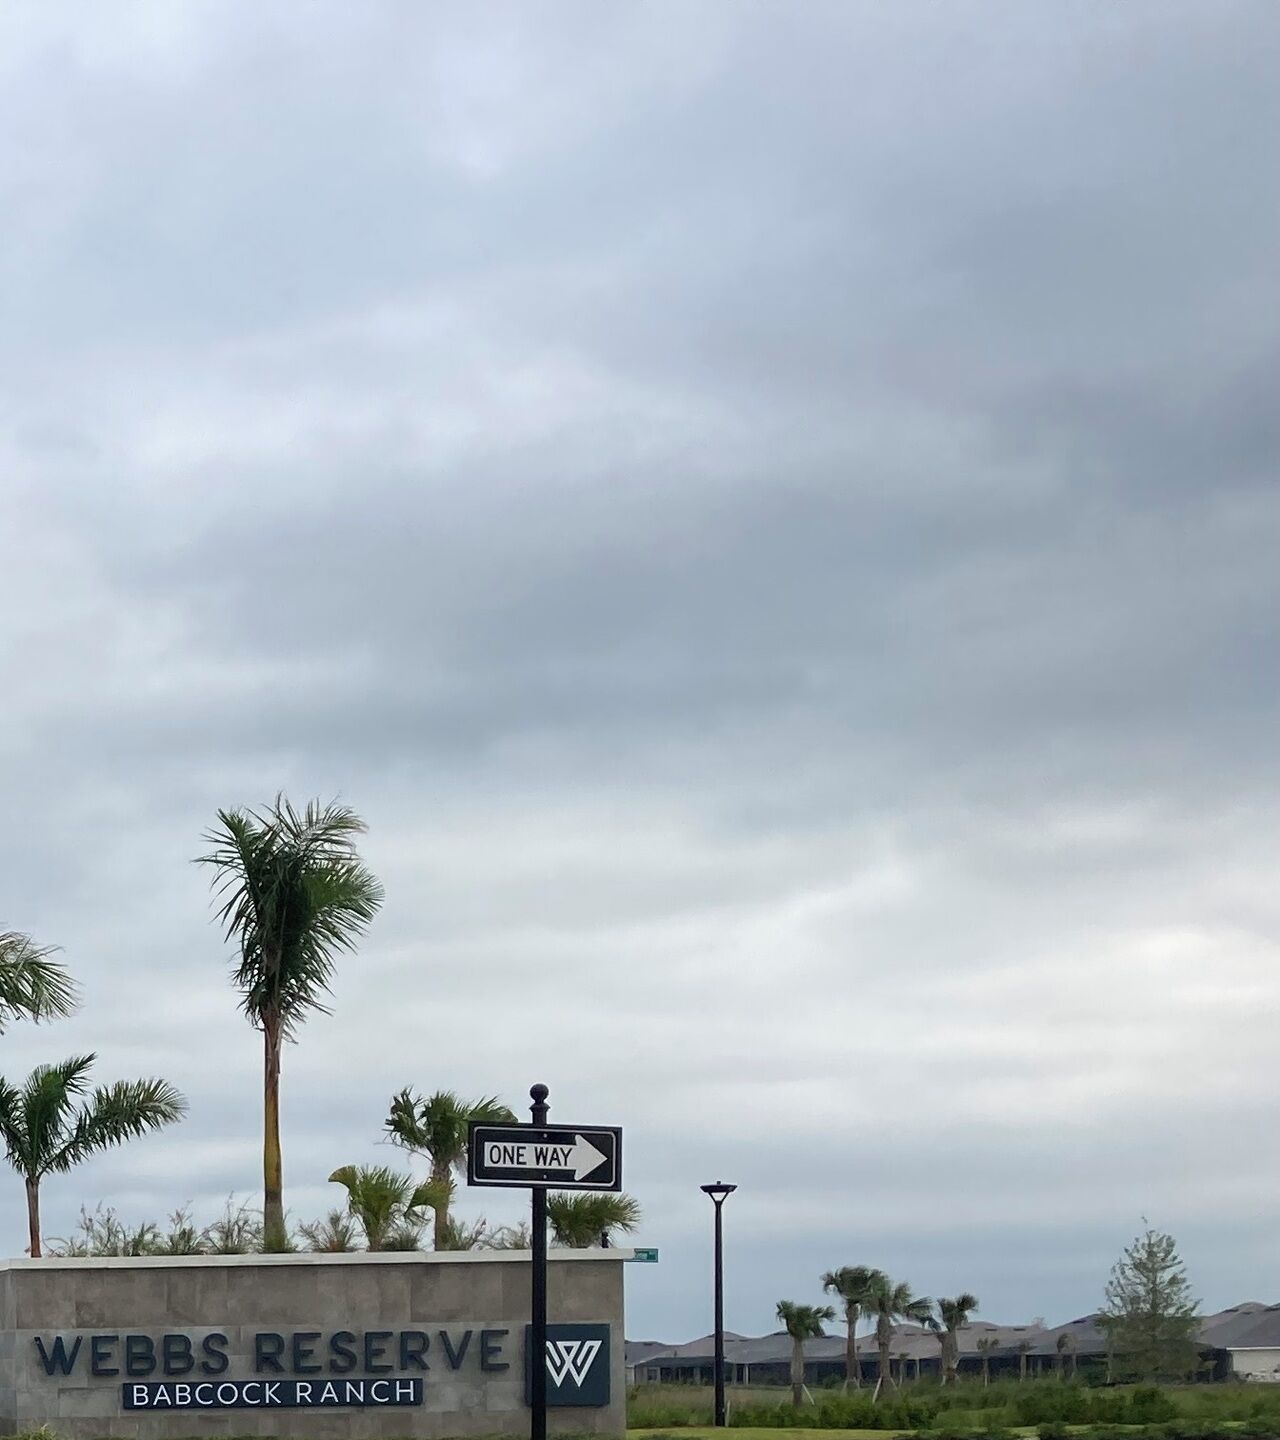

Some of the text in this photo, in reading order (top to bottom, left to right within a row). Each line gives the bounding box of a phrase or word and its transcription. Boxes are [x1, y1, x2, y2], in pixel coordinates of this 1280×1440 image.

[490, 1145, 572, 1166] ONE WAY
[34, 1329, 510, 1376] WEBBS RESERVE
[132, 1379, 417, 1407] BABCOCK RANCH
